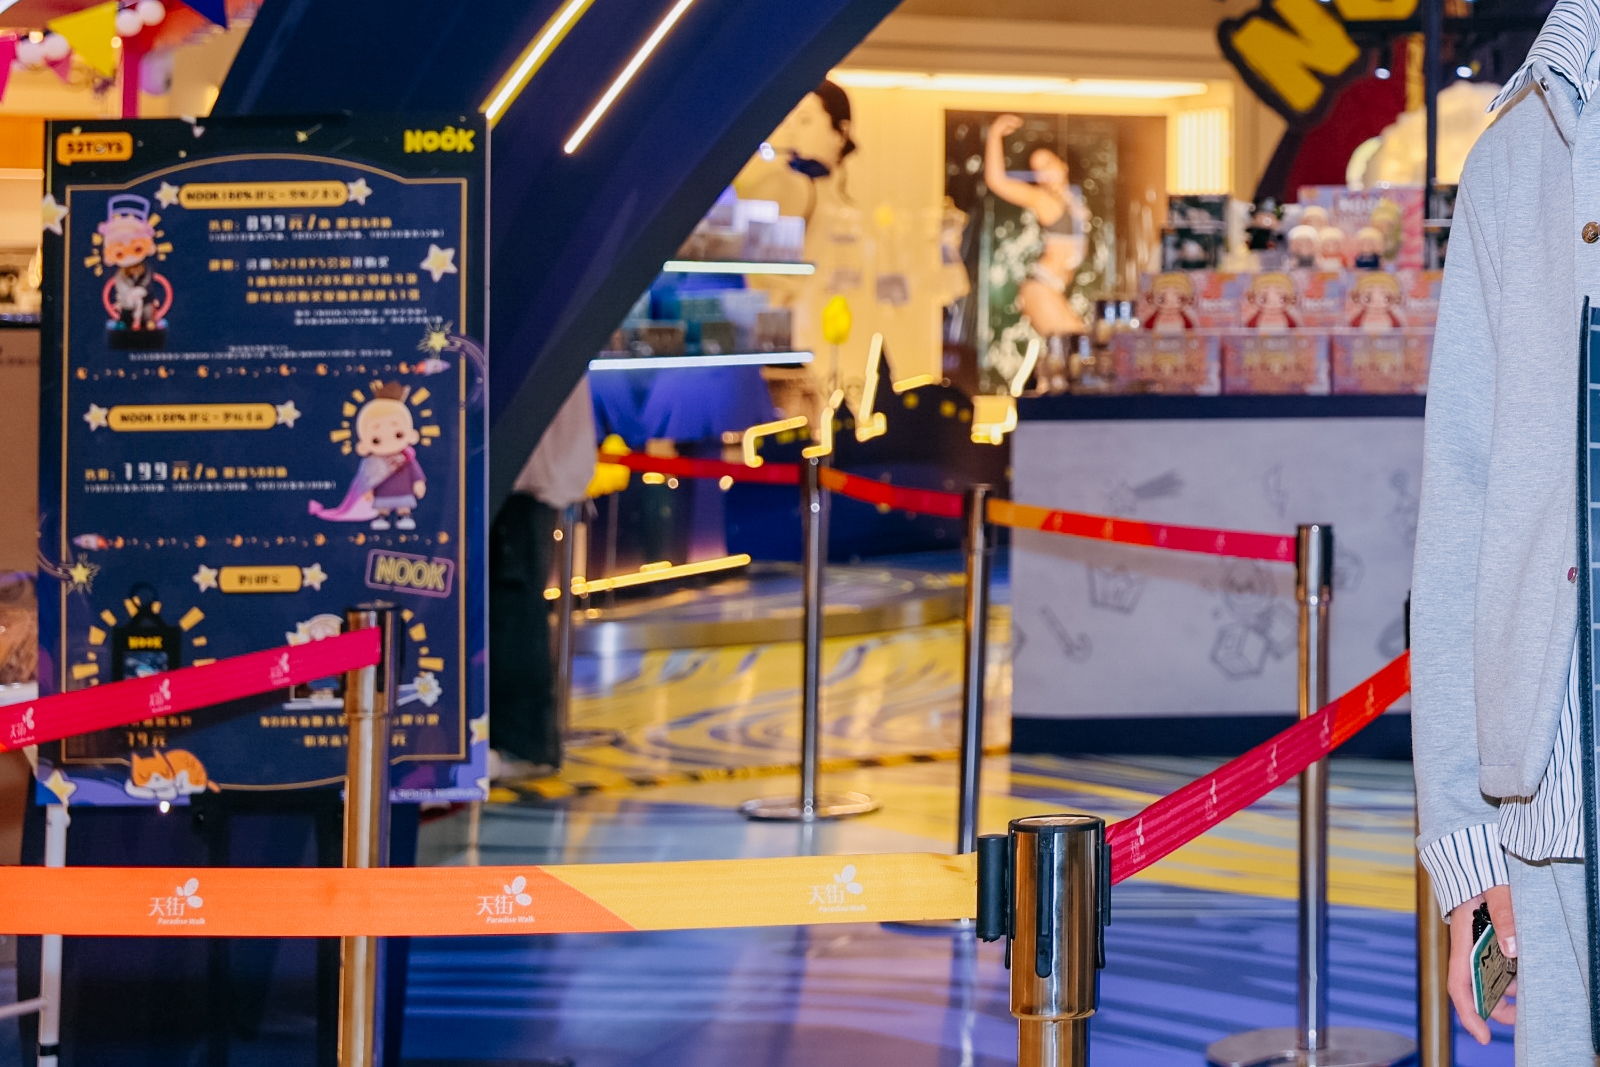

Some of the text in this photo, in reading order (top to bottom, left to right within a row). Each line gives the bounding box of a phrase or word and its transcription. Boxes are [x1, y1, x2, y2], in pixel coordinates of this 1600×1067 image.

[66, 140, 124, 155] 52TOYS
[374, 554, 448, 592] NOOK
[476, 895, 514, 915] 天街
[807, 885, 845, 905] 天街
[148, 896, 186, 917] 天街
[486, 916, 517, 924] Paradise
